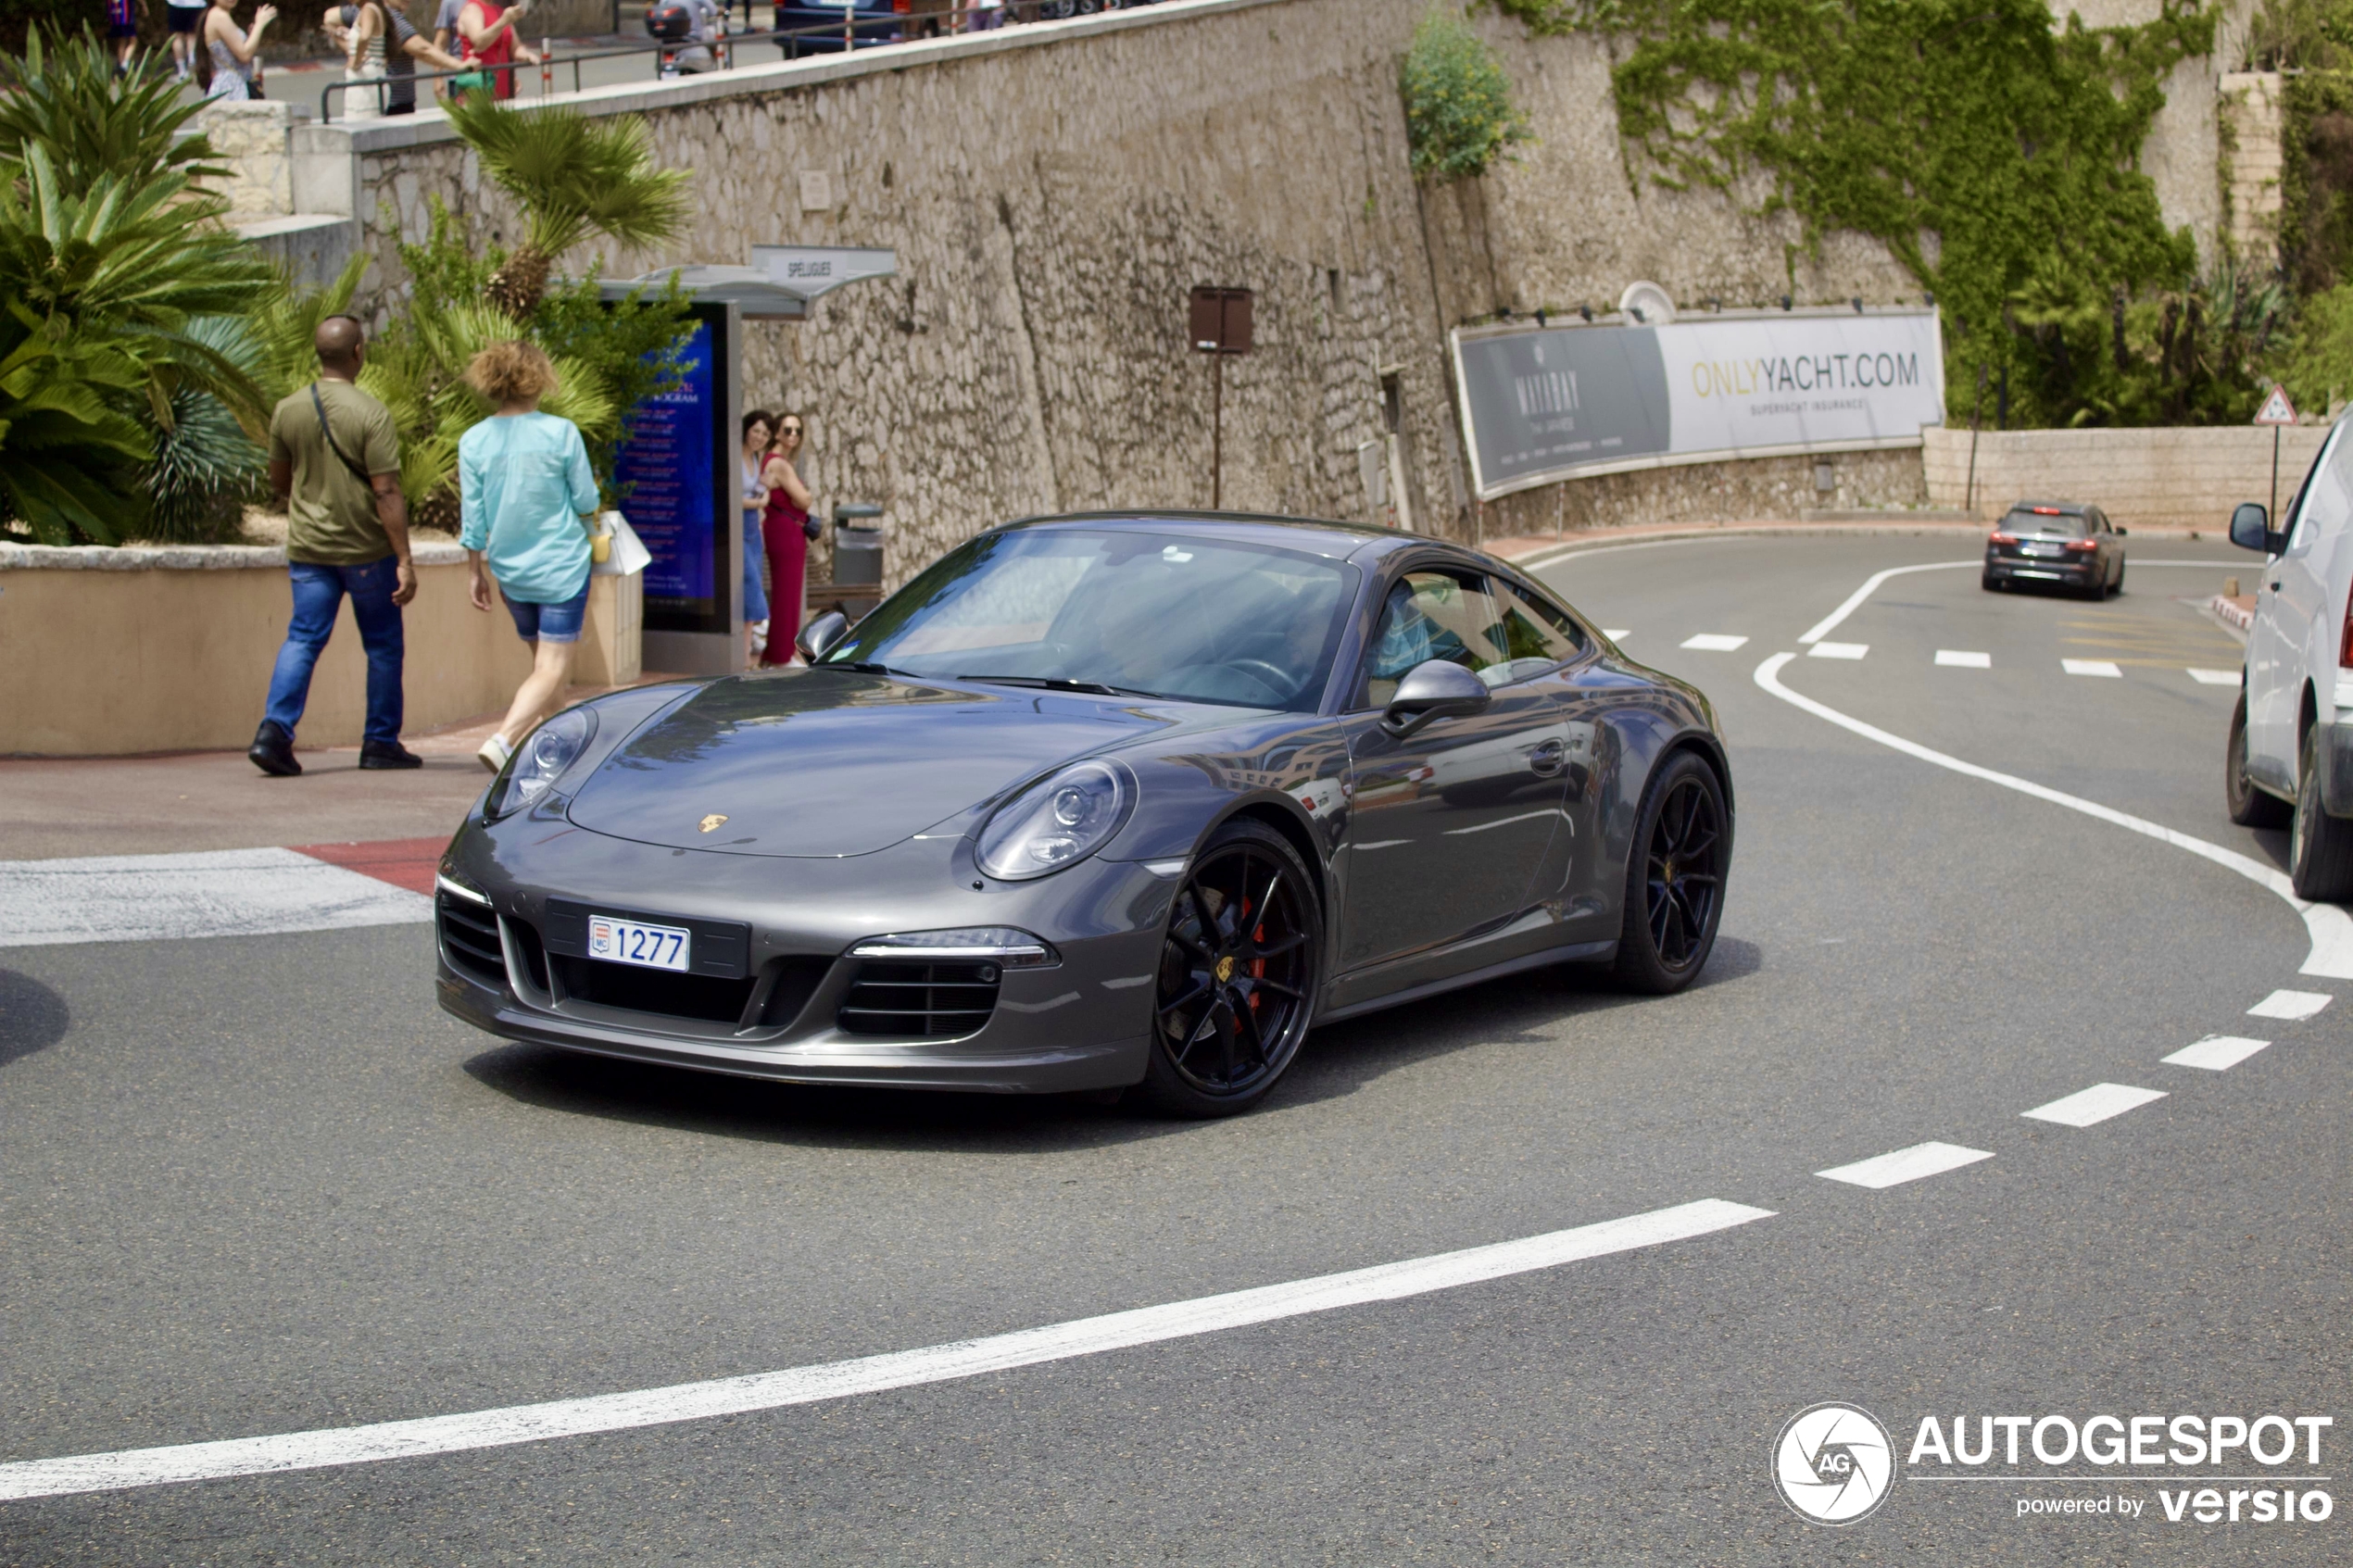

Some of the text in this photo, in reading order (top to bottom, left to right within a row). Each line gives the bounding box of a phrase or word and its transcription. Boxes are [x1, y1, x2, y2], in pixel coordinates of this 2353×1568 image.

[1692, 352, 1919, 398] ONLYYACHT.COM
[1751, 398, 1864, 417] SUPERYACHT INSURANCE
[596, 939, 607, 947] MC
[618, 927, 684, 964] 1277
